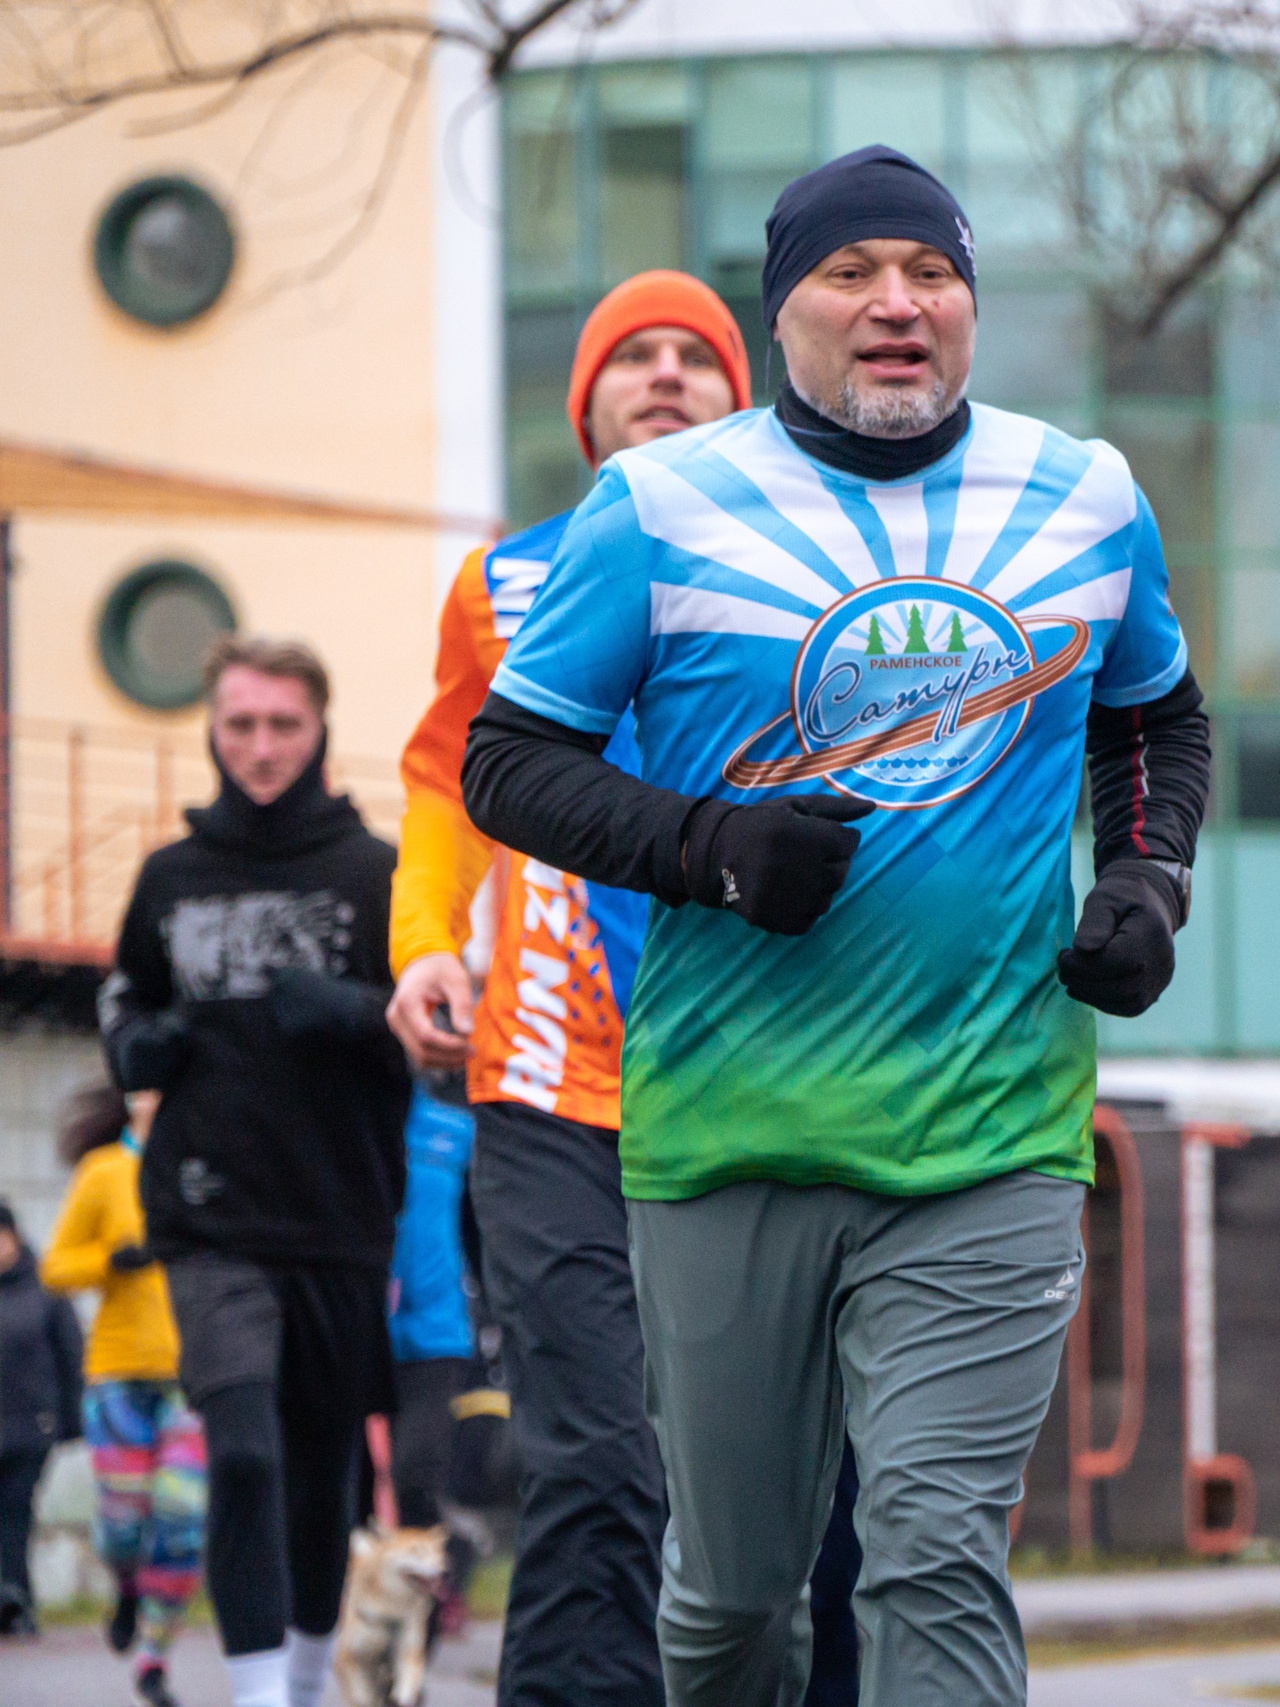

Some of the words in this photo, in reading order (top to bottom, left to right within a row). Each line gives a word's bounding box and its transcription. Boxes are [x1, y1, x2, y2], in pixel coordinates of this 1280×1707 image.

[804, 646, 1031, 744] Сатурн
[869, 655, 963, 671] РАМЕНСКОЕ
[498, 947, 568, 1112] RUN
